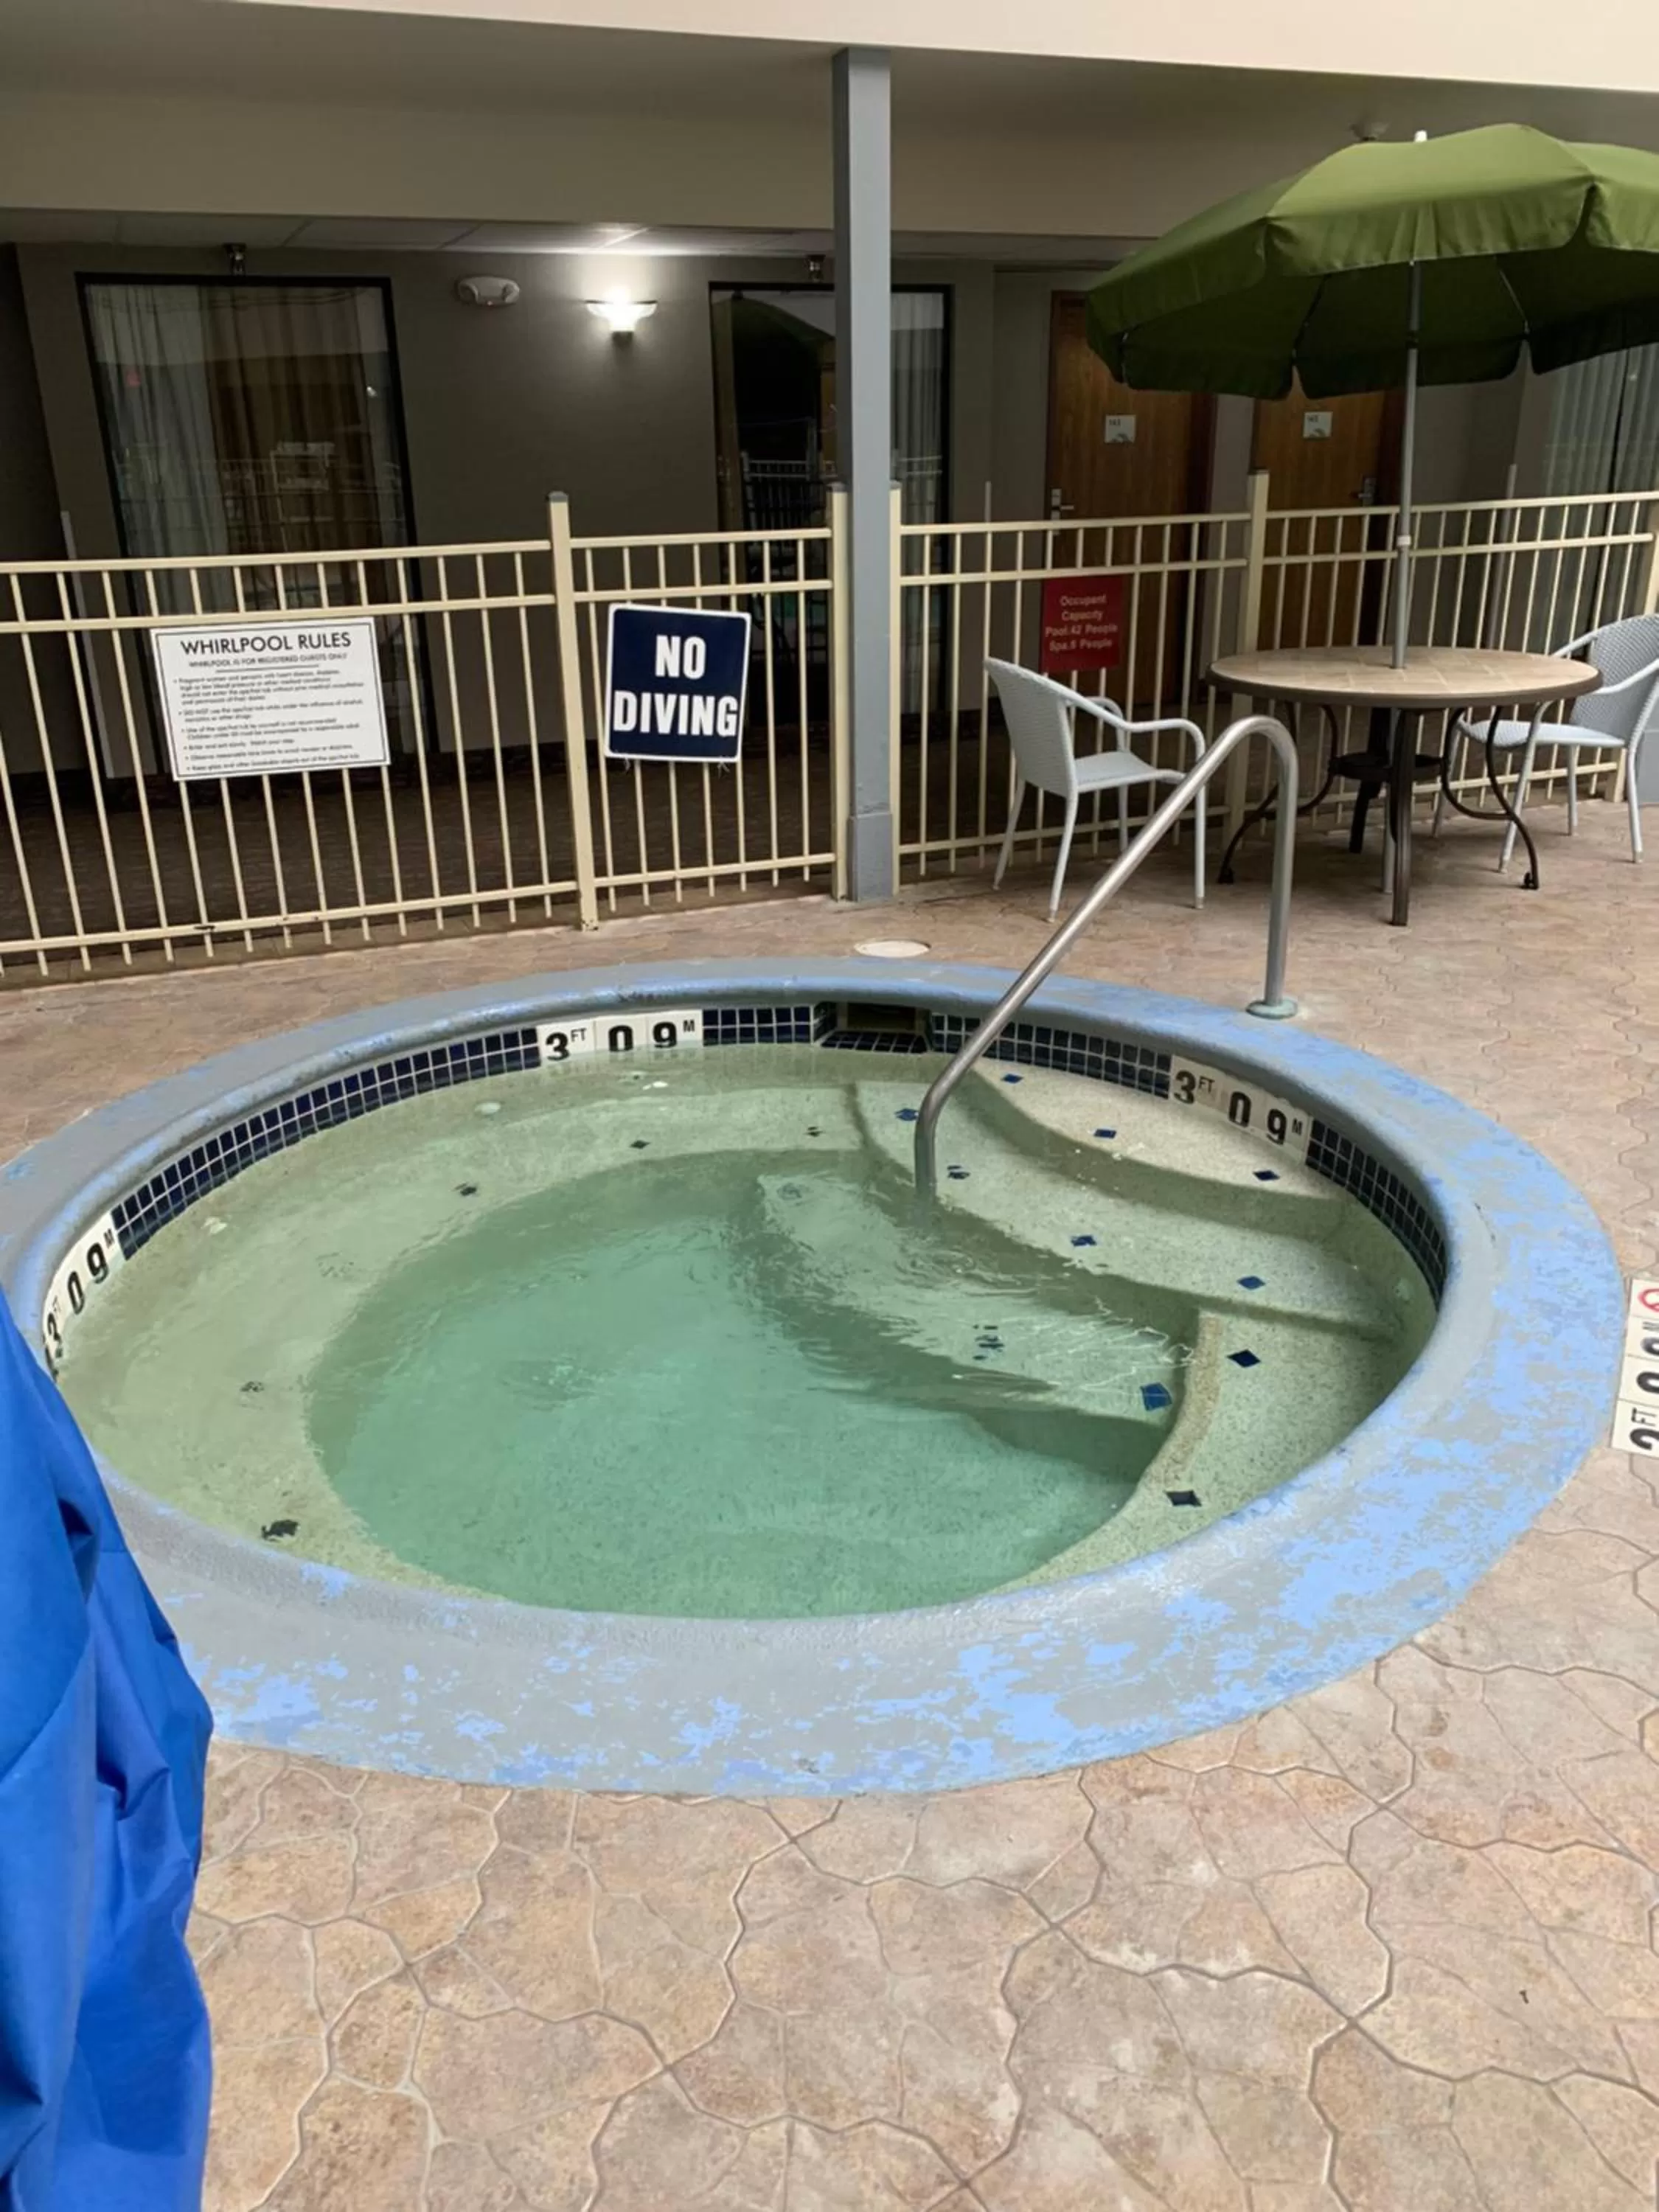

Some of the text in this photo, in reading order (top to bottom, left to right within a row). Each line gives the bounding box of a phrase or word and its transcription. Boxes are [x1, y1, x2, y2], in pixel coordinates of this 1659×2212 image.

[1060, 594, 1106, 606] Occupant
[1062, 611, 1103, 622] Capacity
[1085, 624, 1118, 635] People
[180, 631, 352, 655] WHIRLPOOL RULES
[1079, 639, 1113, 650] People
[655, 635, 706, 680] NO
[613, 689, 738, 737] DIVING
